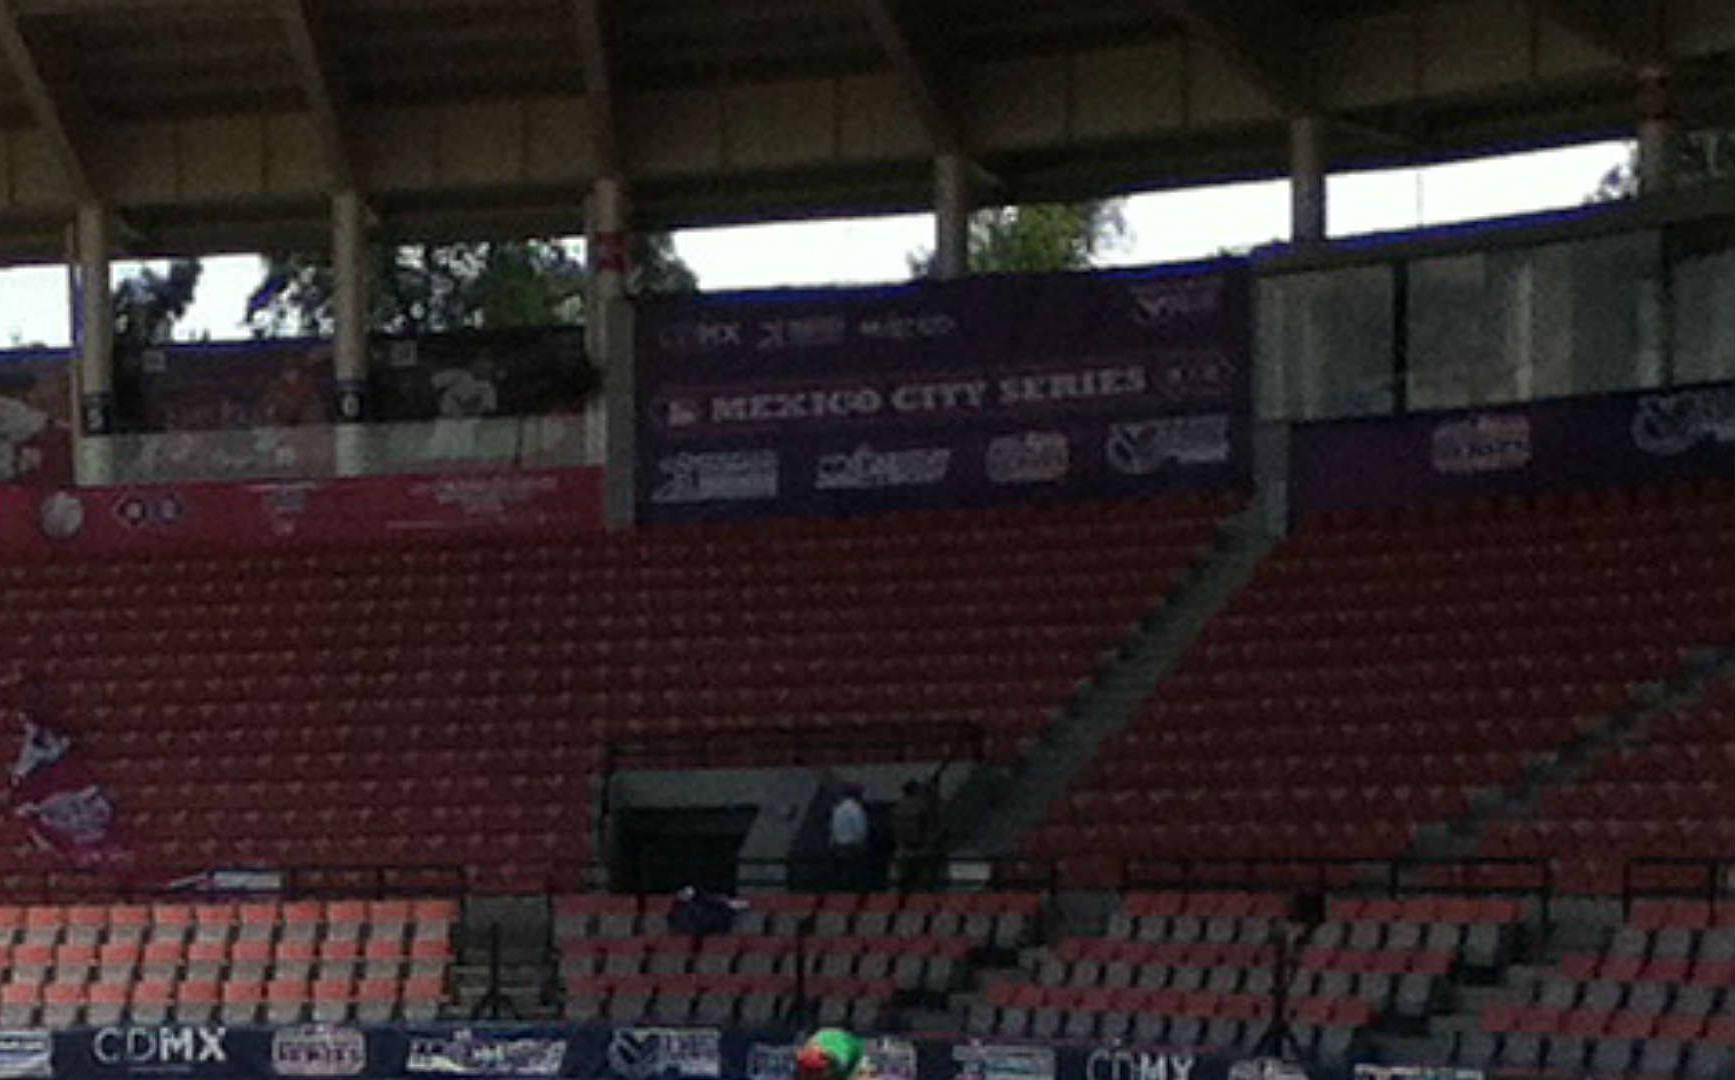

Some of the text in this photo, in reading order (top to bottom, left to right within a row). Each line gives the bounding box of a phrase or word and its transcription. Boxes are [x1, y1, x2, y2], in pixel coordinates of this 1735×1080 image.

[708, 363, 1147, 423] MEXICO CITY SERIES
[92, 1027, 228, 1064] CDMX
